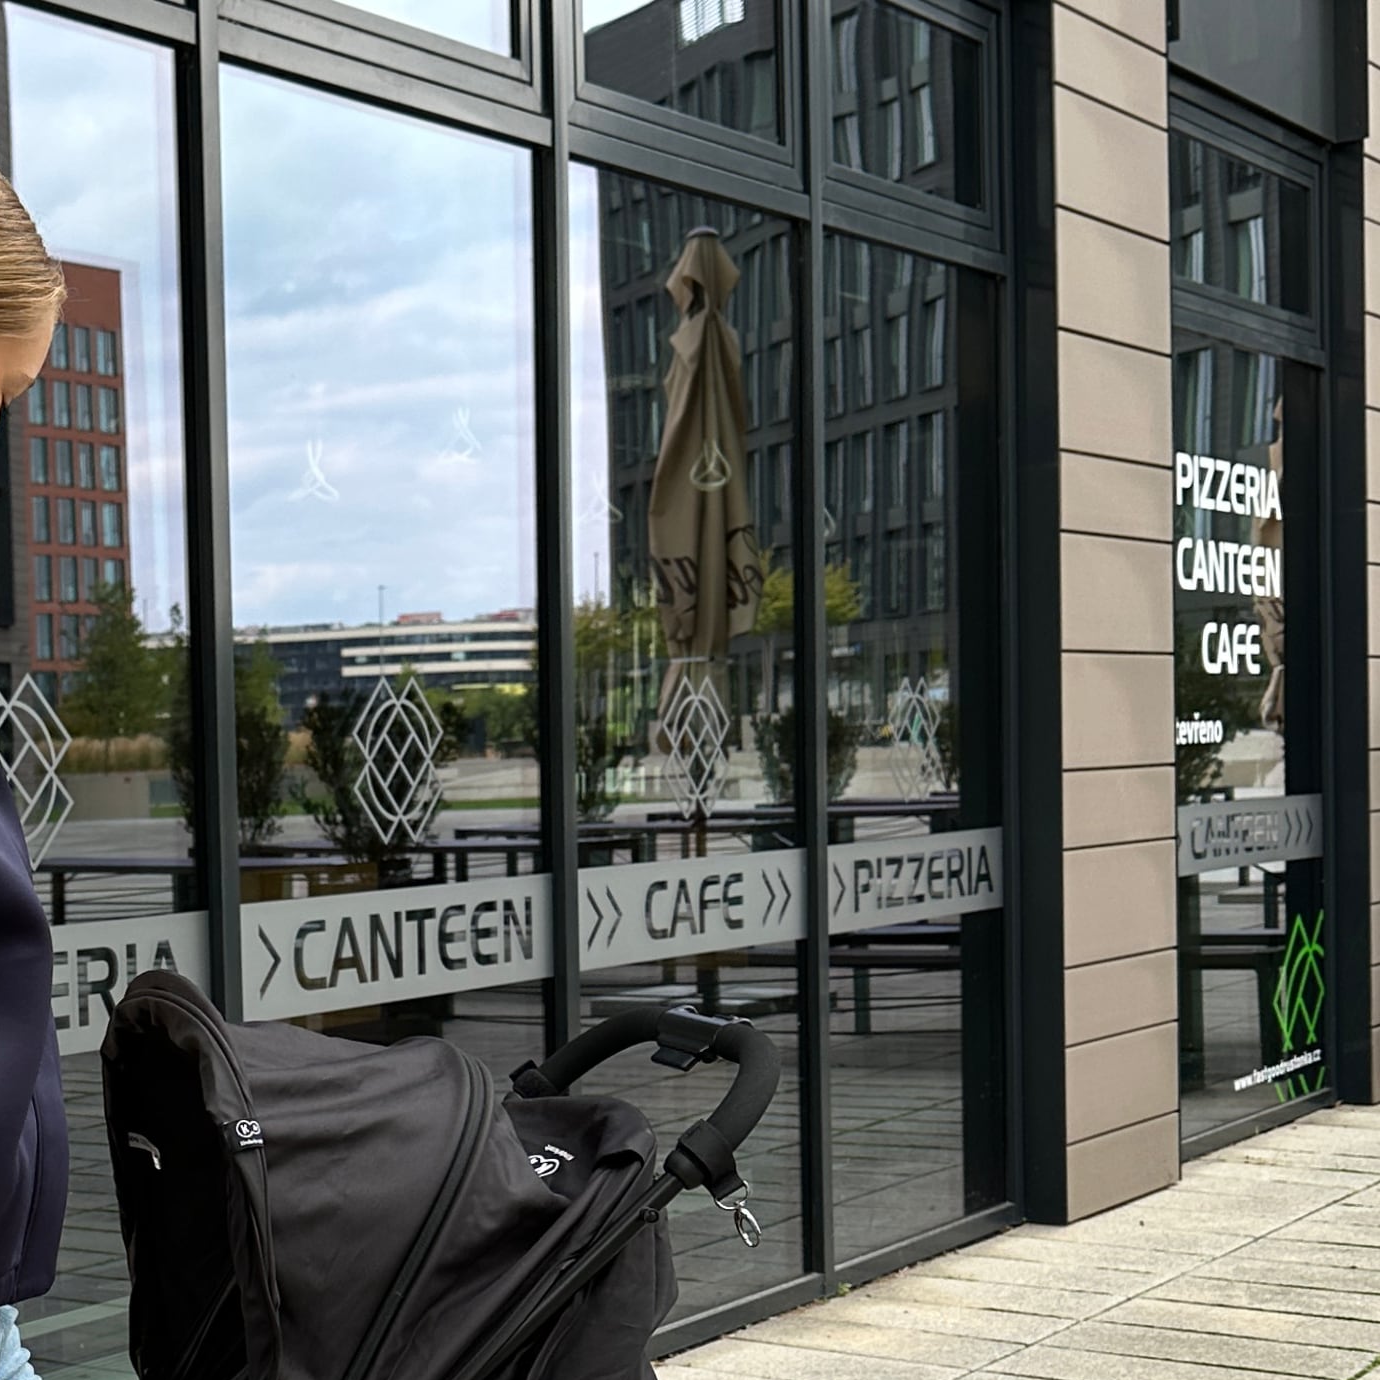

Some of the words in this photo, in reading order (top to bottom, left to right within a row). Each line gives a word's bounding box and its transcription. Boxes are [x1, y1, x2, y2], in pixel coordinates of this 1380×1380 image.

[1175, 452, 1282, 520] PIZZERIA
[1177, 537, 1281, 597] CANTEEN
[1202, 622, 1261, 675] CAFE
[644, 872, 745, 940] CAFE
[852, 844, 995, 914] PIZZERIA
[292, 896, 534, 991] CANTEEN
